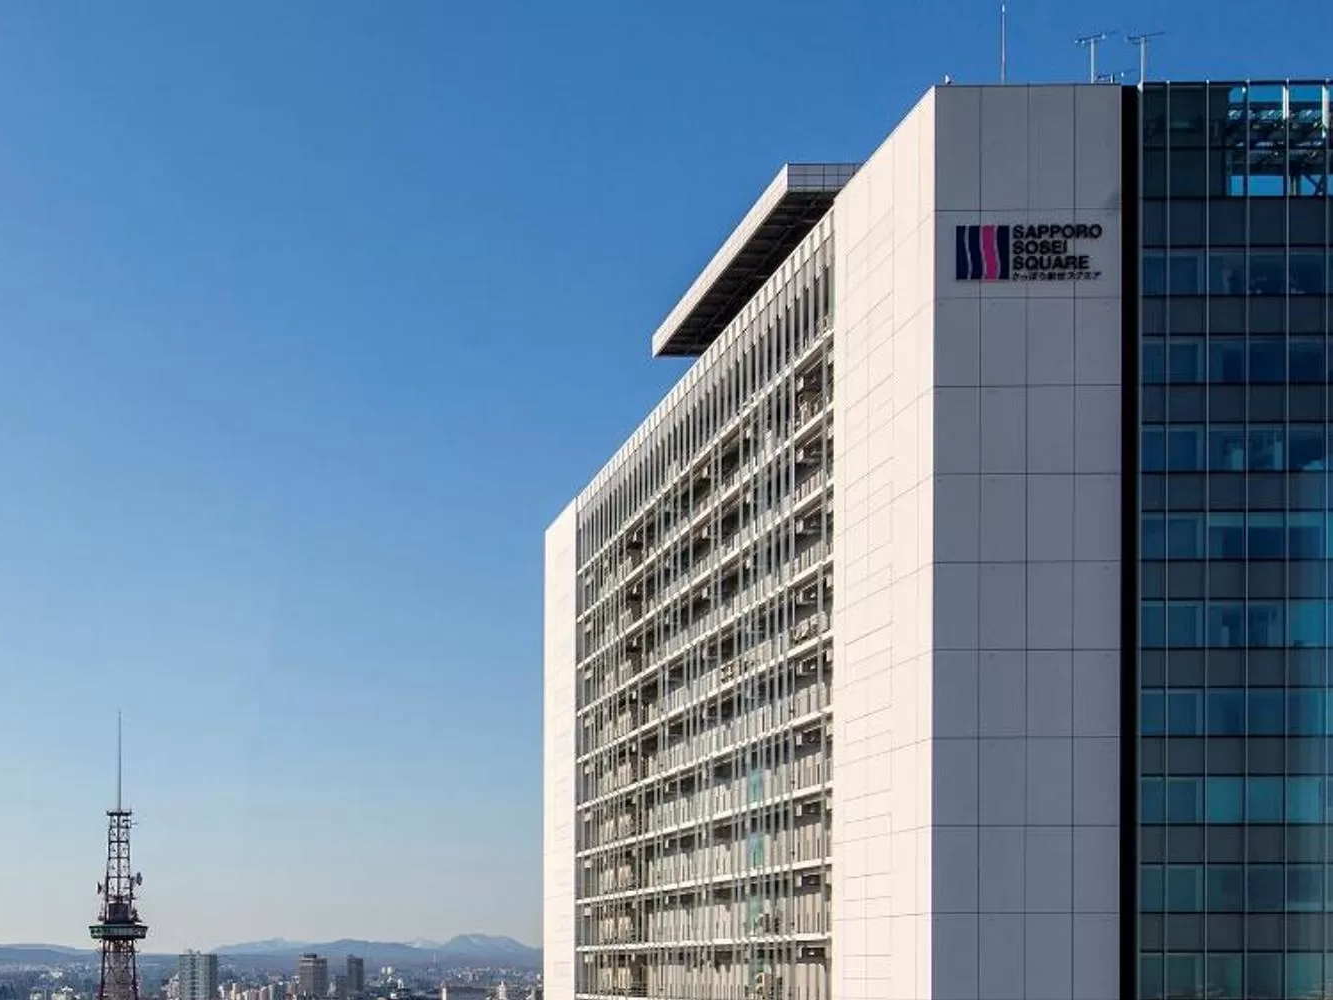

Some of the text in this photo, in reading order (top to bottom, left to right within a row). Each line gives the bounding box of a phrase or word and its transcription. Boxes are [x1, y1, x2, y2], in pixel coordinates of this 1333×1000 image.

[1012, 223, 1102, 238] SAPPORO
[1012, 240, 1067, 254] SOSEI
[1012, 255, 1090, 270] SQUARE
